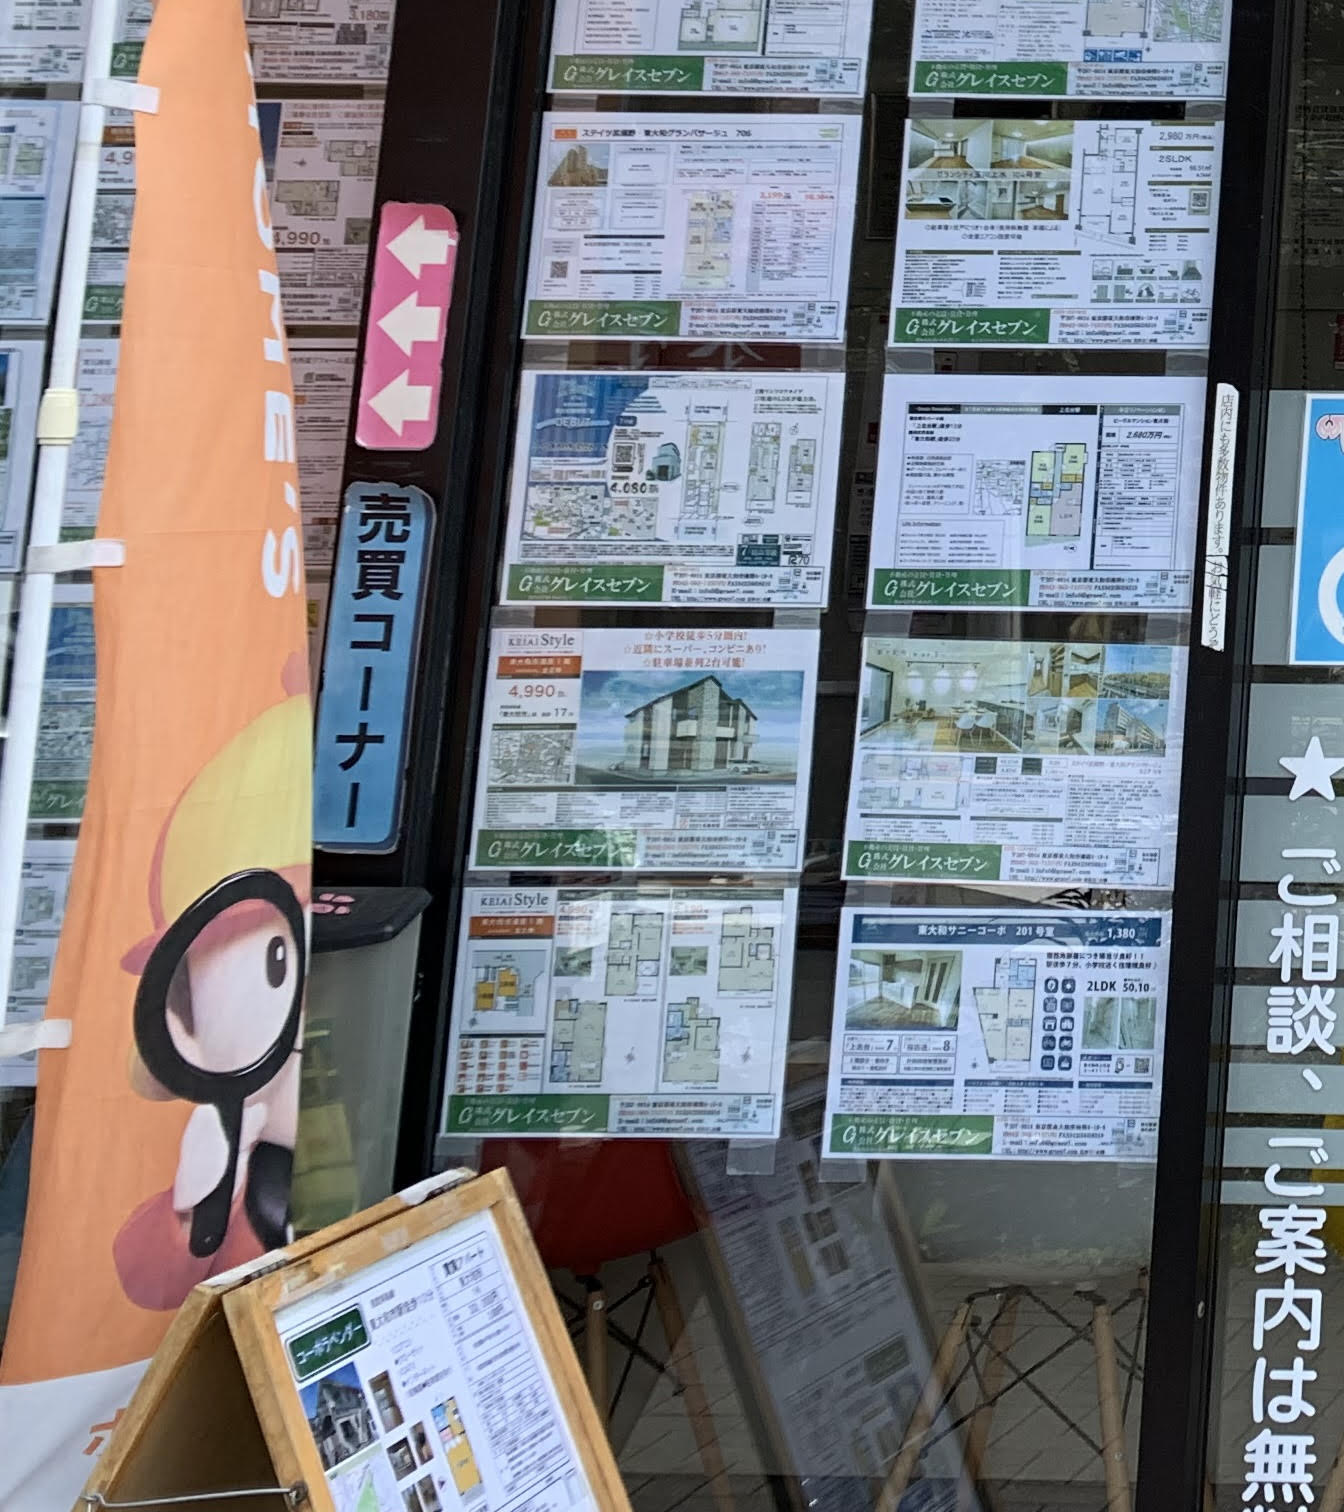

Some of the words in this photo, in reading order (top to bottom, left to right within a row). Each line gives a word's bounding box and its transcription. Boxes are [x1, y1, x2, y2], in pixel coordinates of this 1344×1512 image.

[595, 64, 692, 83] グレイスセブン
[958, 71, 1055, 88] グレイスセブン
[571, 312, 667, 329] グレイスセブン
[937, 318, 1037, 337] グレイスセブン
[550, 577, 651, 593] グレイスセブン
[917, 579, 1017, 598] グレイスセブン
[336, 492, 412, 830] 売買コーナー
[888, 853, 988, 872] グレイスセブン
[1107, 928, 1136, 939] 1,380
[1087, 981, 1116, 992] 2LDK
[492, 1107, 597, 1125] グレイスセブン
[875, 1123, 984, 1144] グレイスセブン
